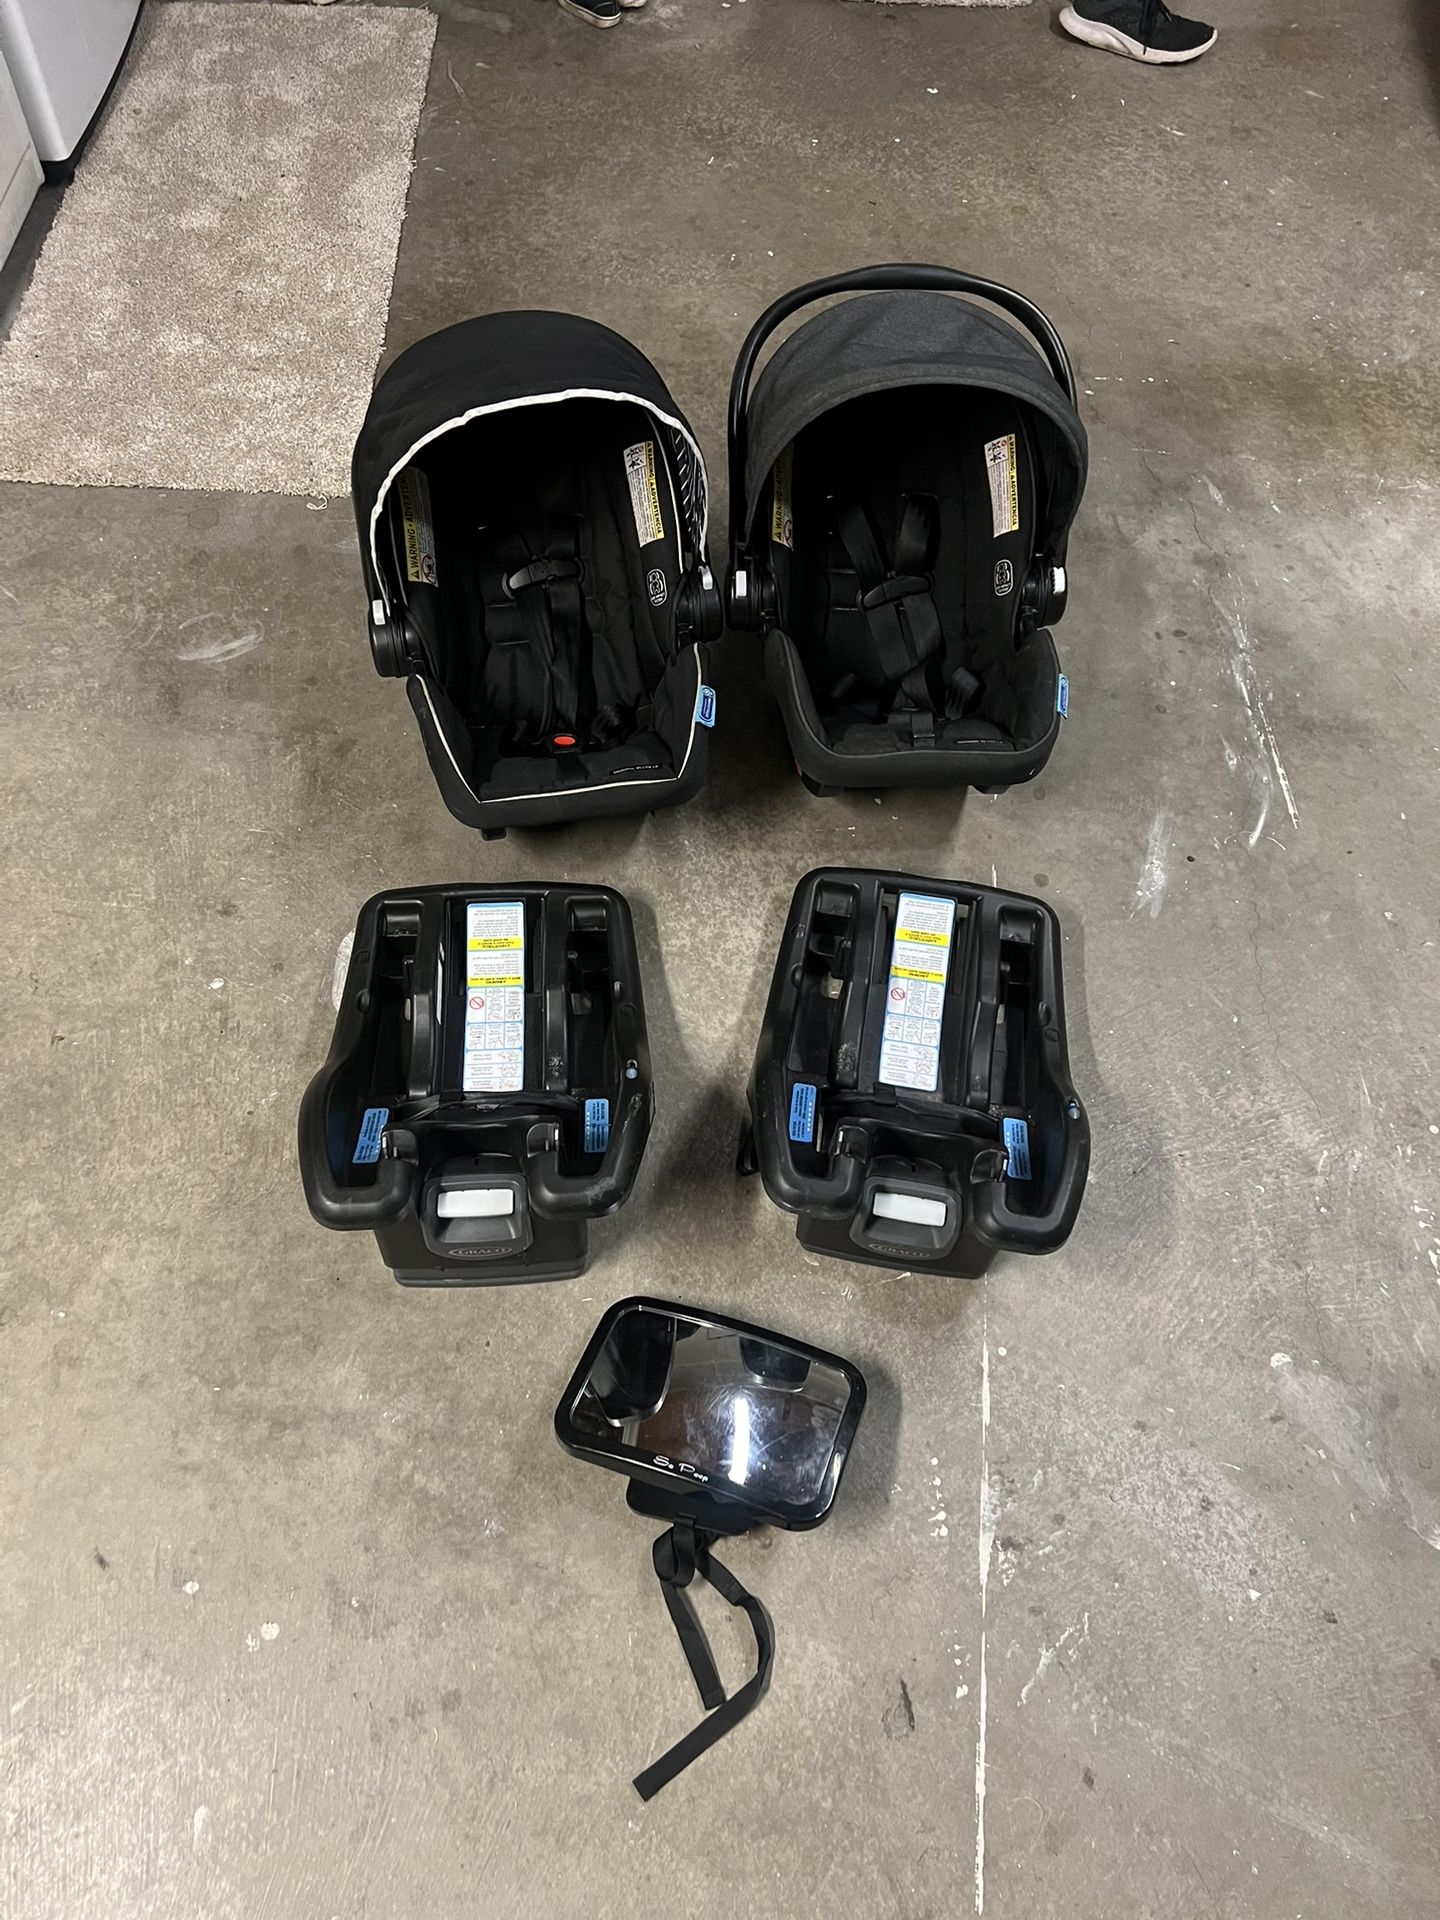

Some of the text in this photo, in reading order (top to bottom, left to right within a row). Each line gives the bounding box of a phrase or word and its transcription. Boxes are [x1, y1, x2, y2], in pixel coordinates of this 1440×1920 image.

[651, 488, 662, 534] ADVERTENCIA
[775, 489, 783, 530] WARNING
[407, 528, 419, 569] WARNING
